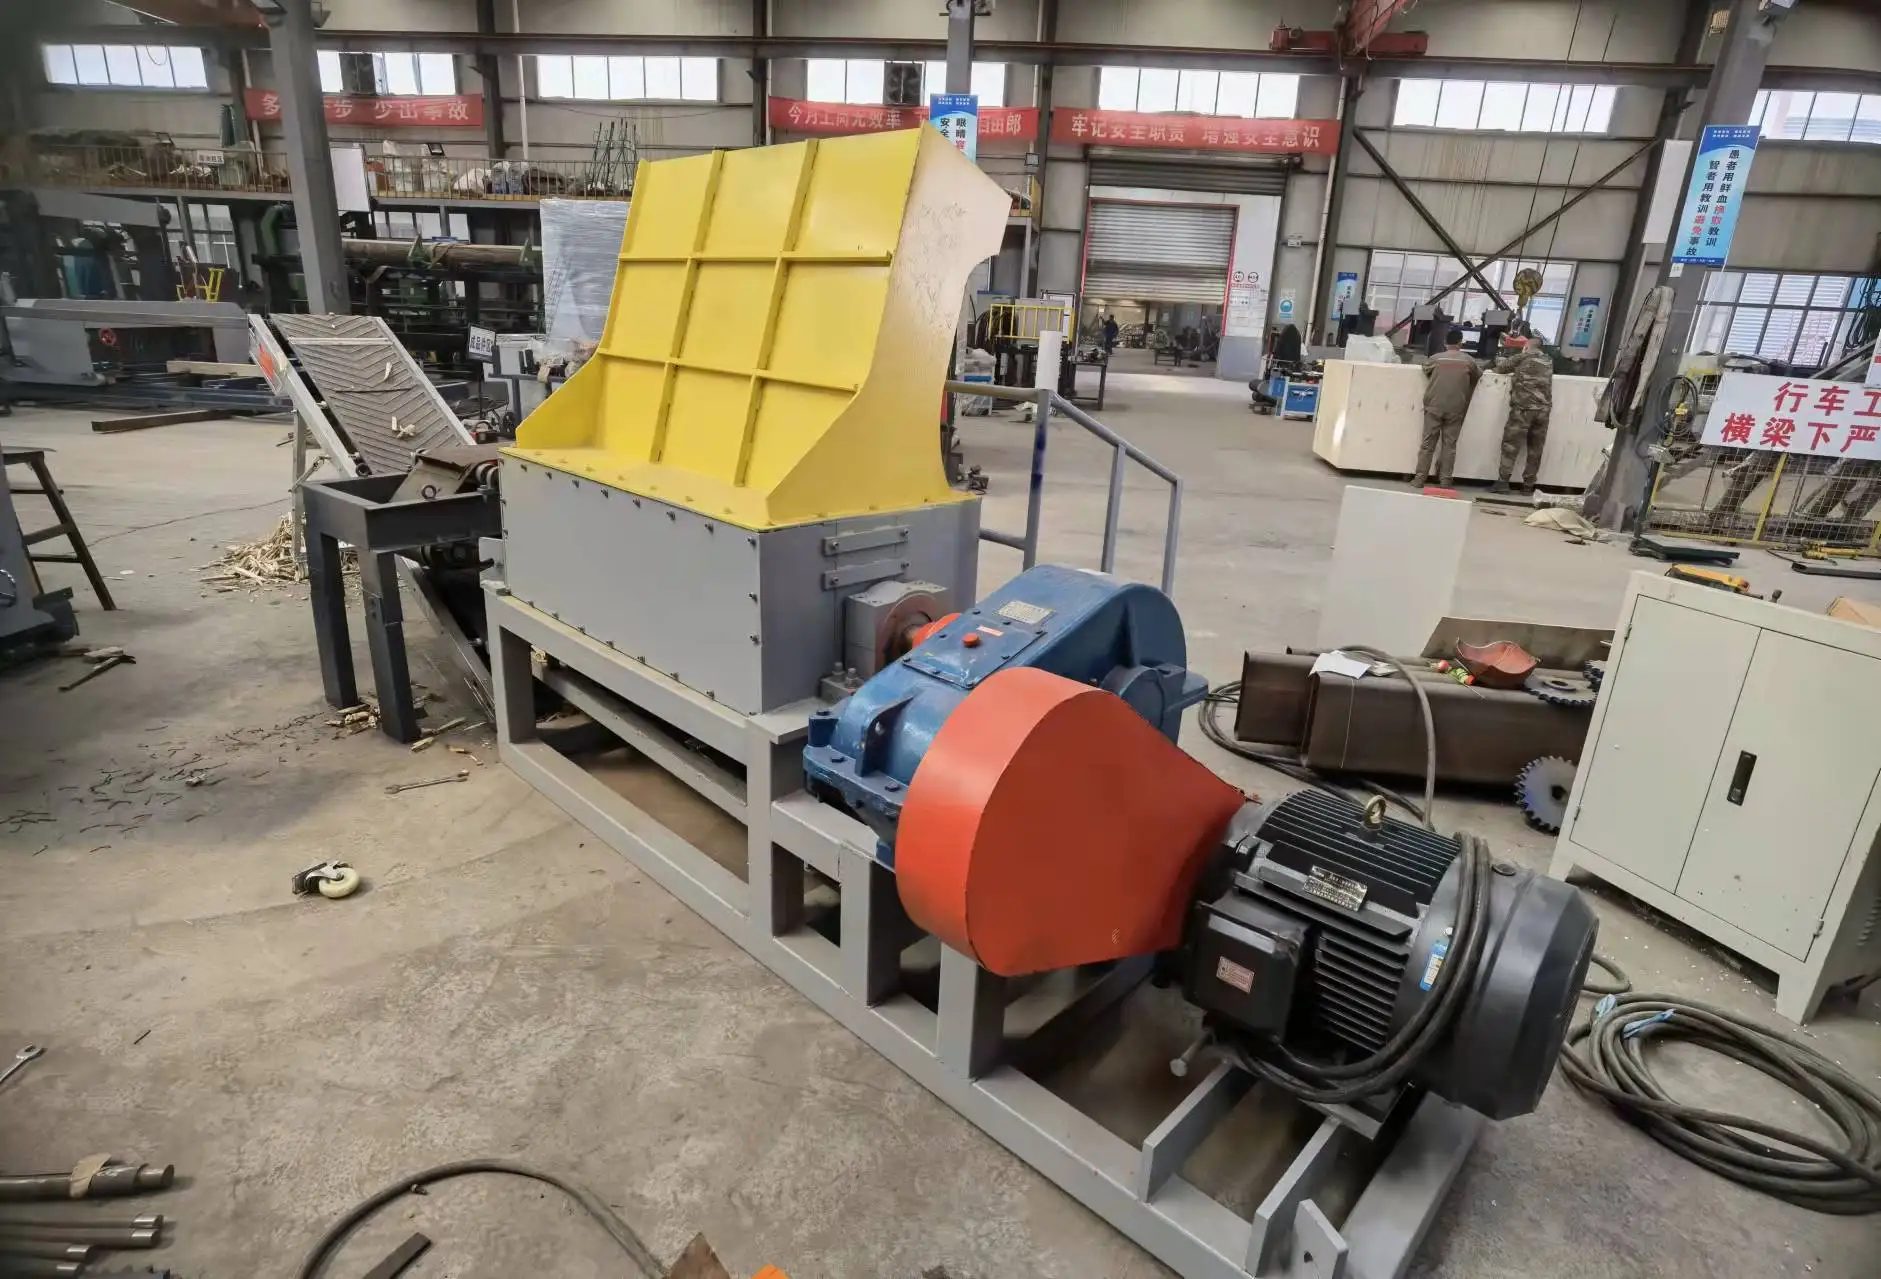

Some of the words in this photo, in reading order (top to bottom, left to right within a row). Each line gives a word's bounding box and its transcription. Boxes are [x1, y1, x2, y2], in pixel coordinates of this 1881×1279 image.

[1774, 381, 1881, 417] 行车工
[1720, 412, 1881, 452] 横梁下严
